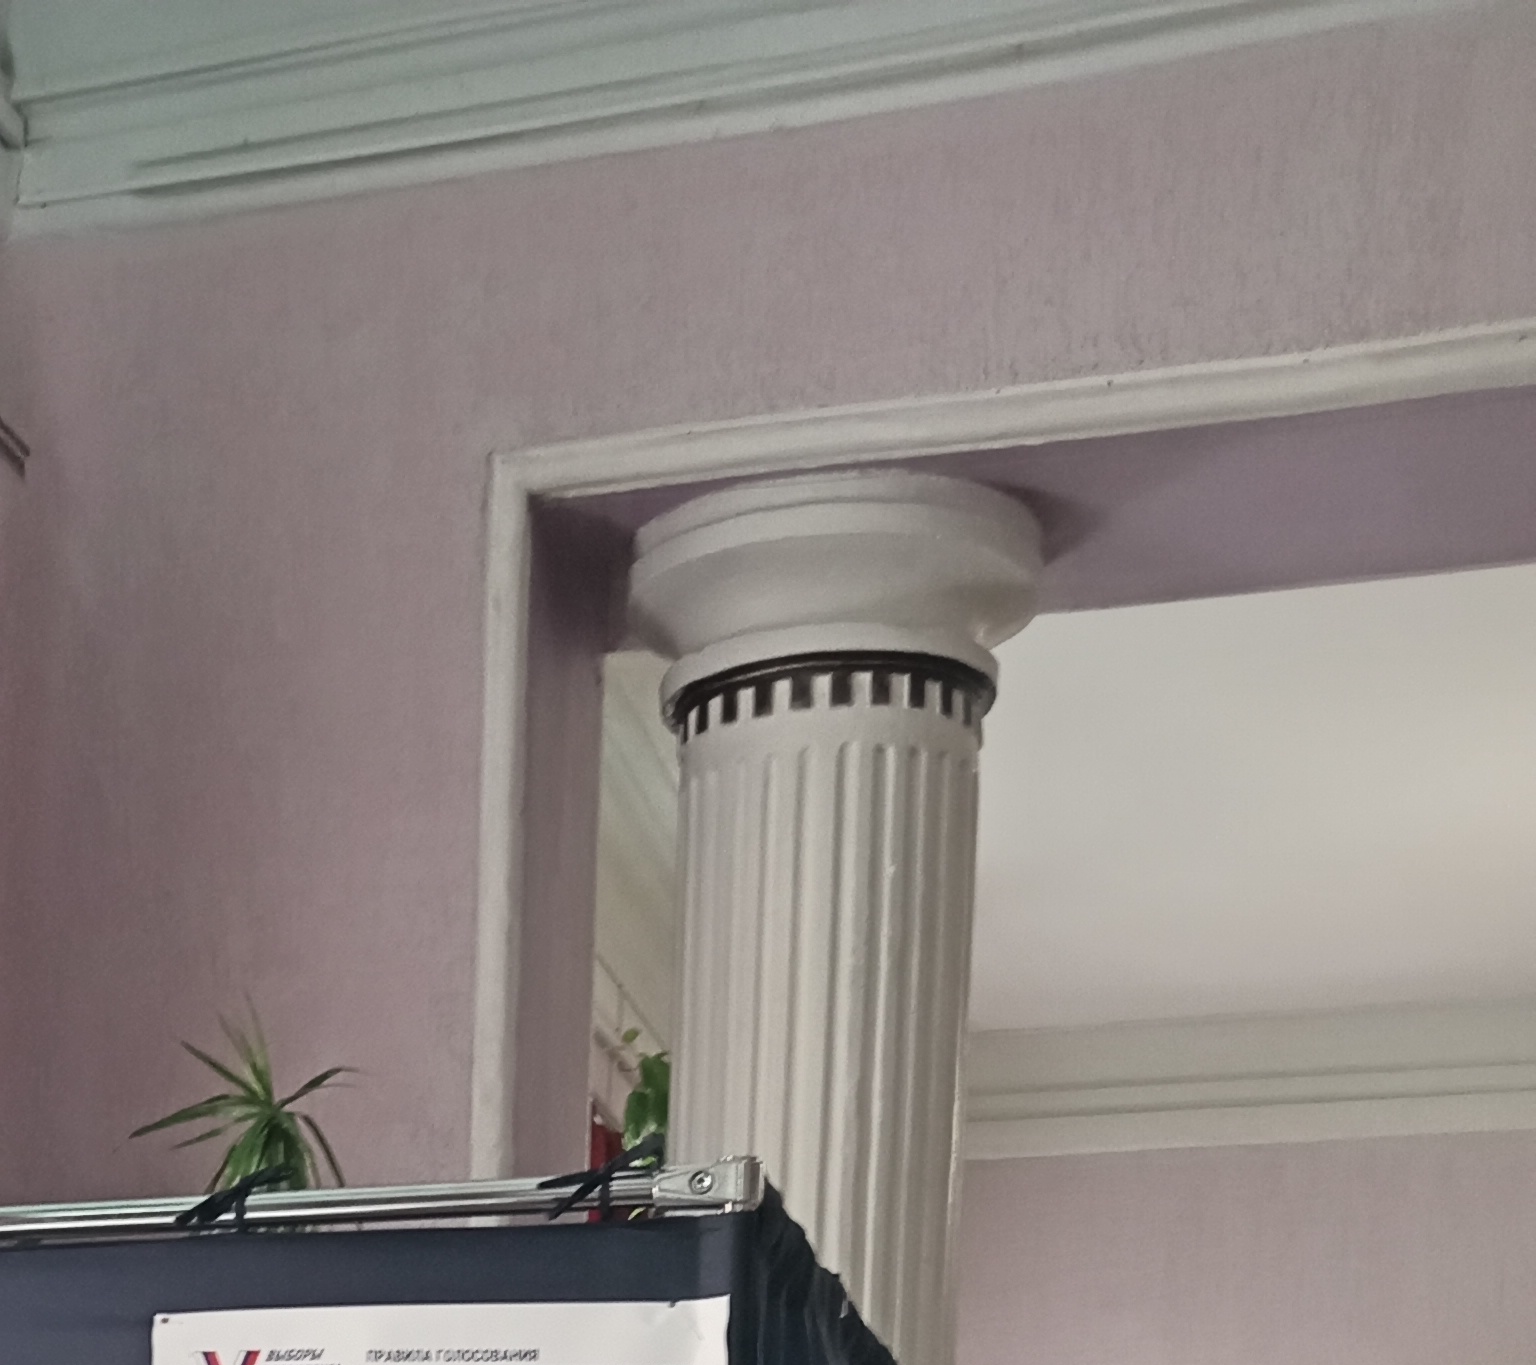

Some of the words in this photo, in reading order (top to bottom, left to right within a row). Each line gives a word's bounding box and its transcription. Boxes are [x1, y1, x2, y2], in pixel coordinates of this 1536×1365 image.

[265, 1348, 325, 1362] ВЫБОРЫ
[365, 1349, 431, 1362] ПРАВИЛА
[435, 1348, 539, 1362] ГОЛОСОВАНИЯ
